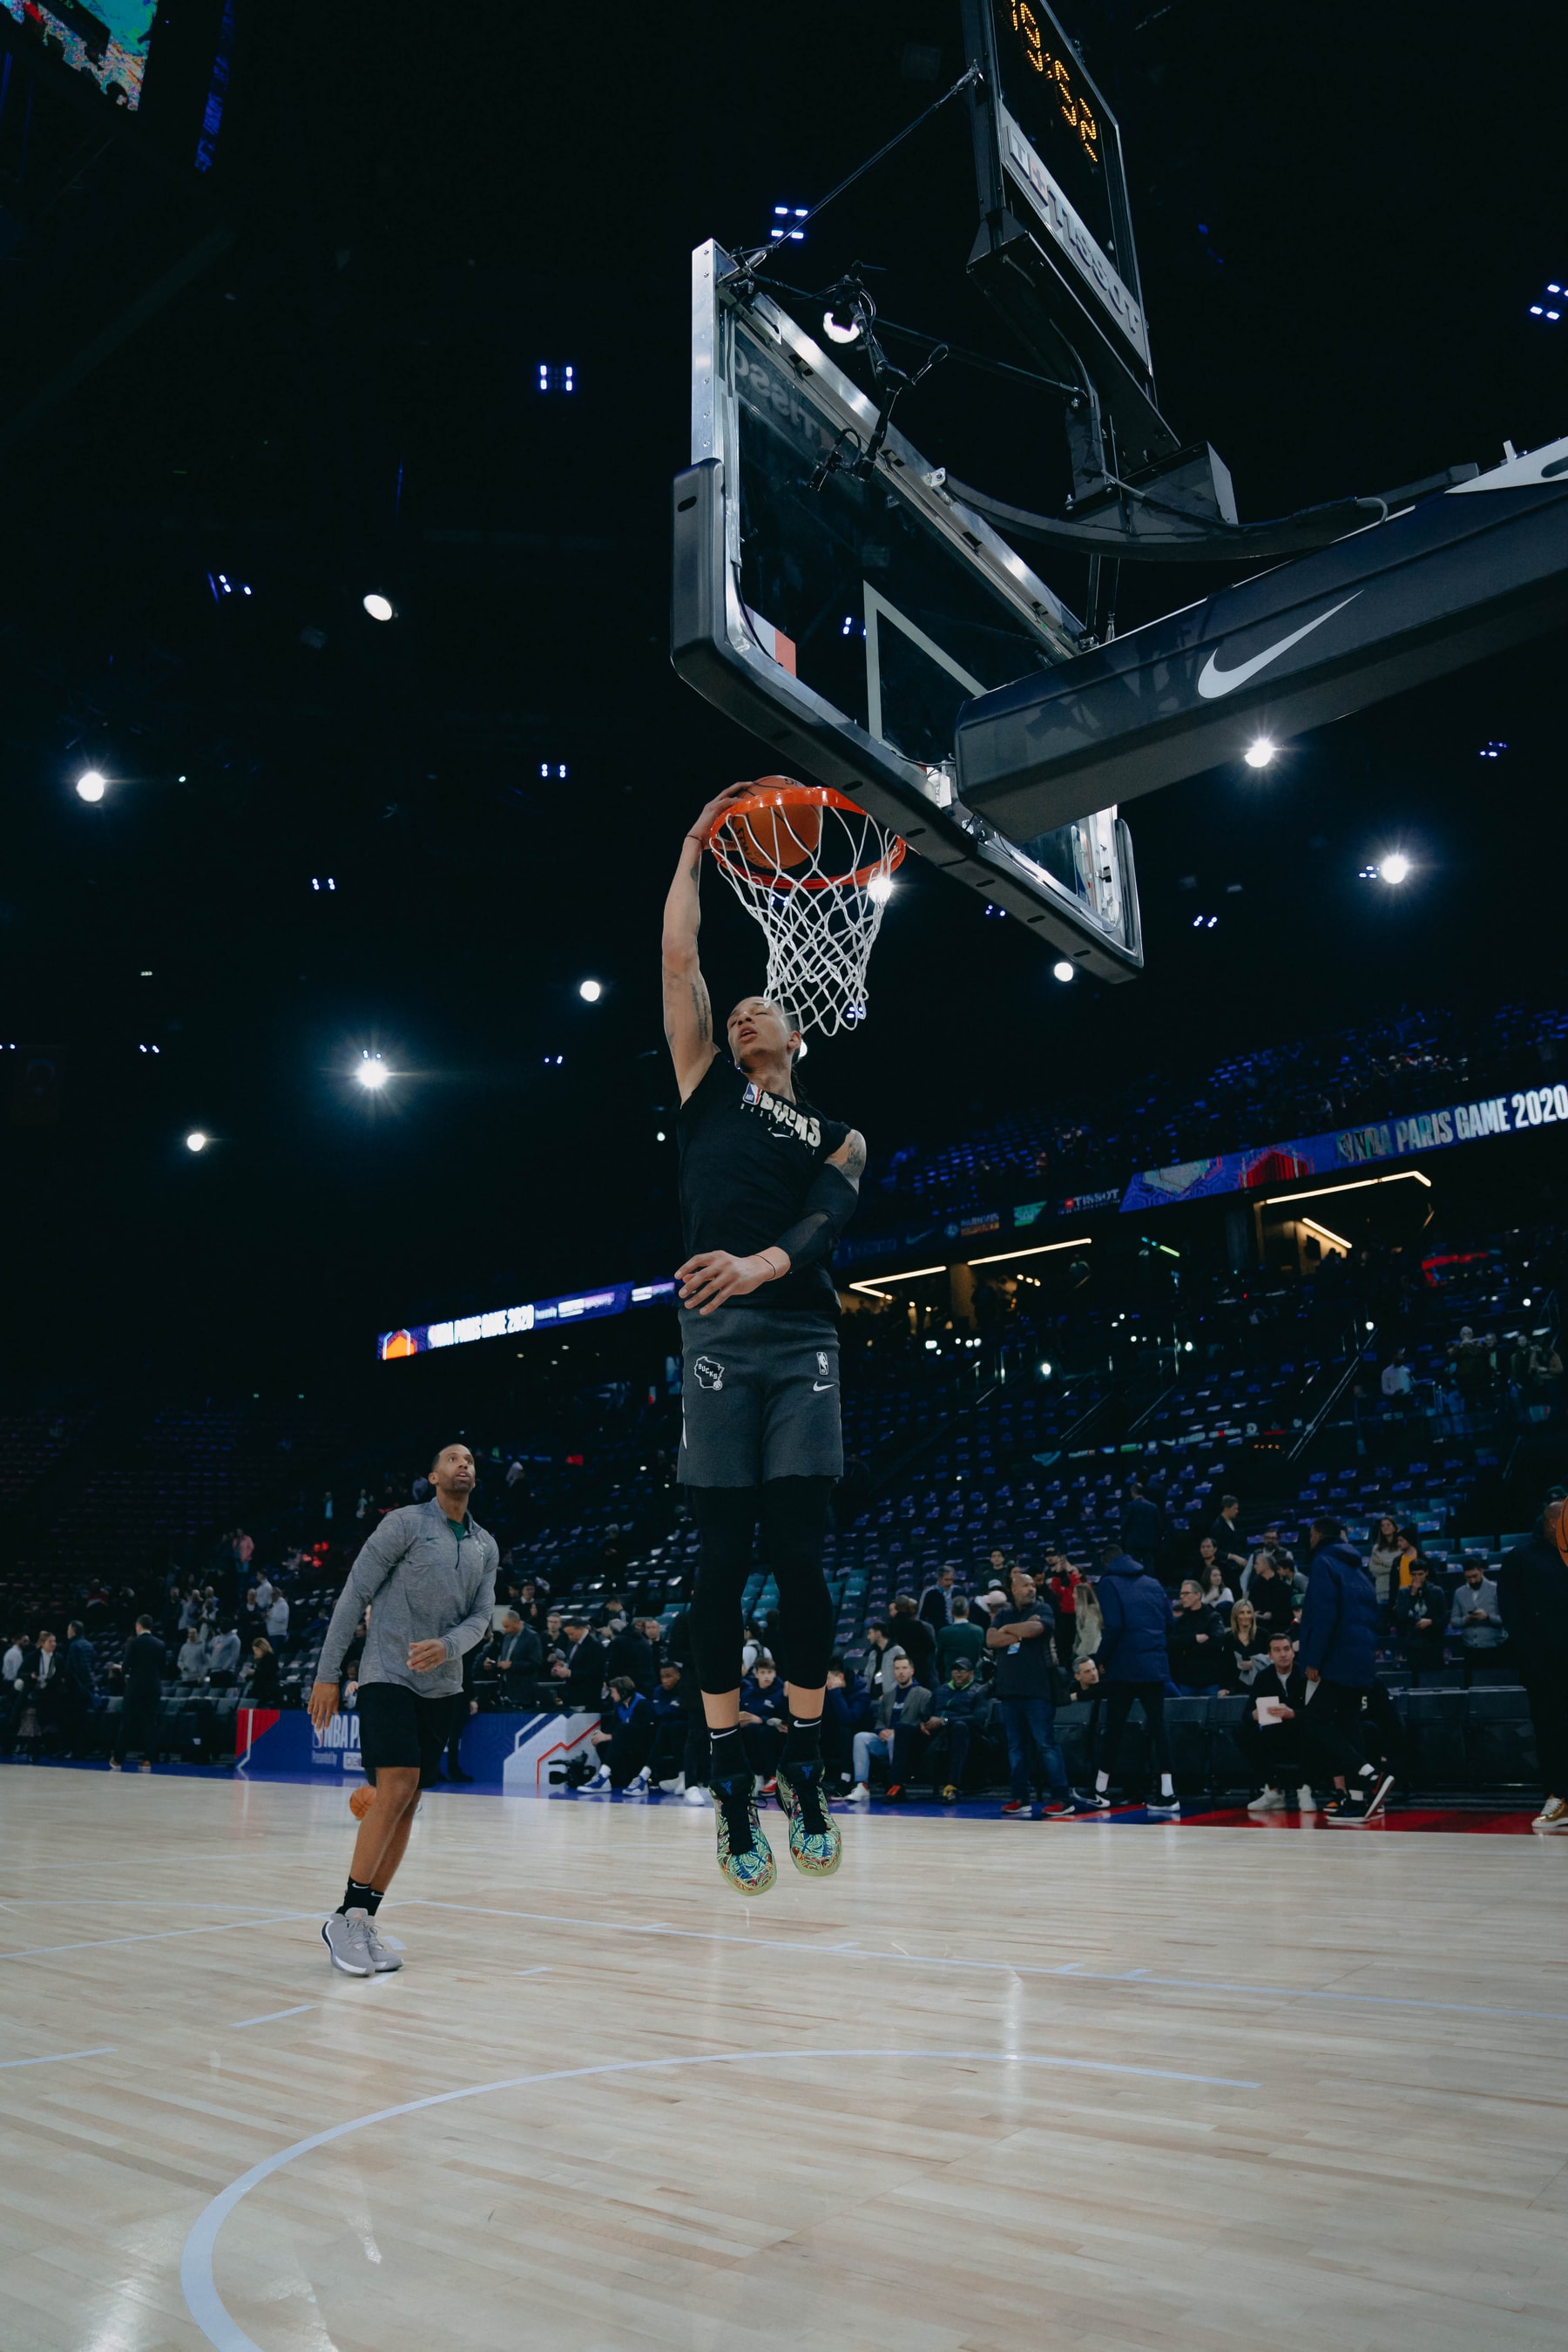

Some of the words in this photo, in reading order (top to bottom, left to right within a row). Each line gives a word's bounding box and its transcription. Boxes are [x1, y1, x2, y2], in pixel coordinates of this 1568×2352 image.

[1047, 183, 1139, 334] TISSOT
[1396, 1111, 1454, 1153] PARIS
[1454, 1098, 1511, 1141] GAME
[1511, 1084, 1568, 1129] 2020
[698, 1363, 718, 1380] BUCKS
